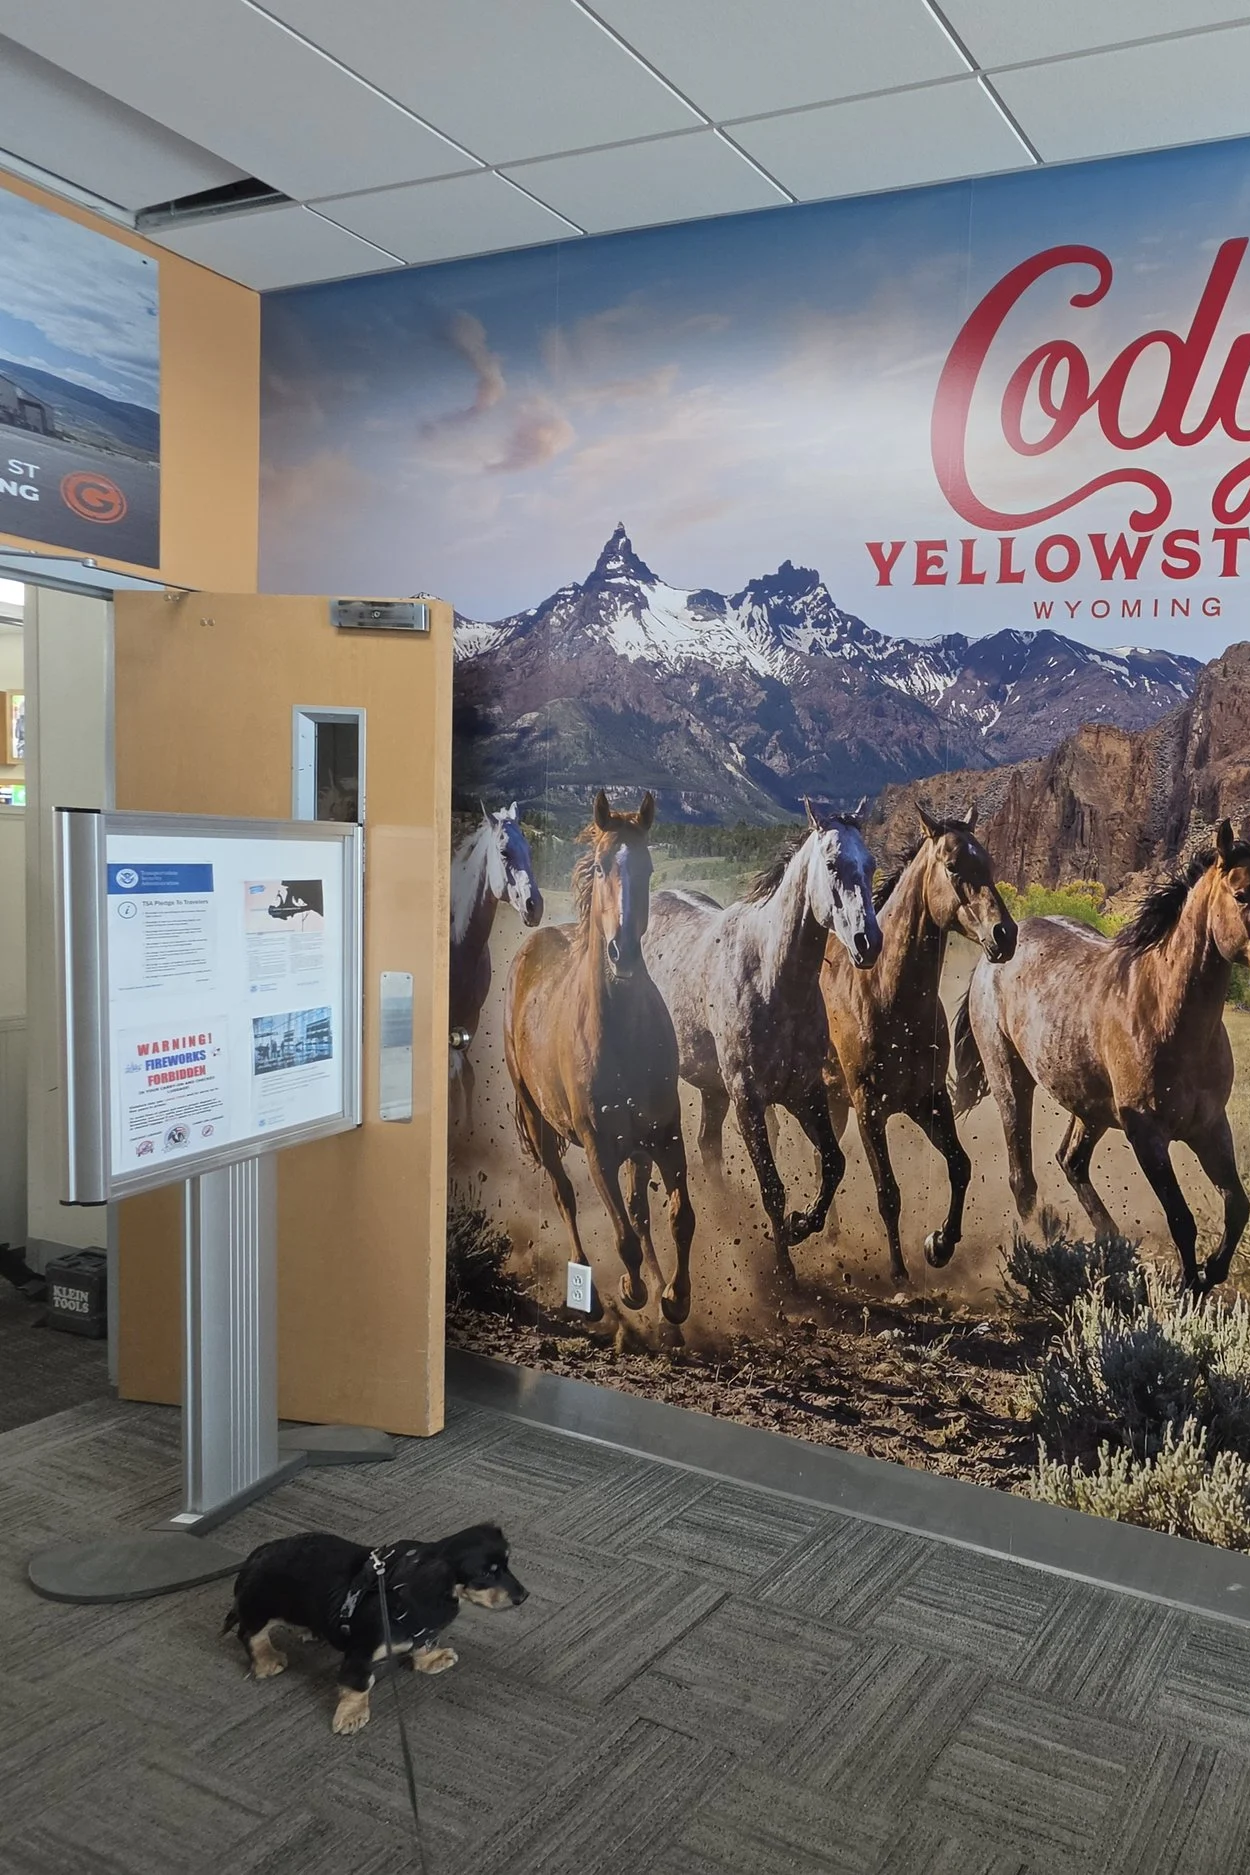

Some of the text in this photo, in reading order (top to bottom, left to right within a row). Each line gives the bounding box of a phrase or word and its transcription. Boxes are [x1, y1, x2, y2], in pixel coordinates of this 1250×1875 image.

[8, 459, 41, 478] ST
[1033, 597, 1222, 620] WYOMING
[137, 1032, 212, 1056] WARNING!
[145, 1050, 206, 1071] FIREWORKS
[147, 1065, 206, 1087] FORBIDDEN
[53, 1285, 89, 1302] KLEIN
[53, 1296, 89, 1313] TOOLS
